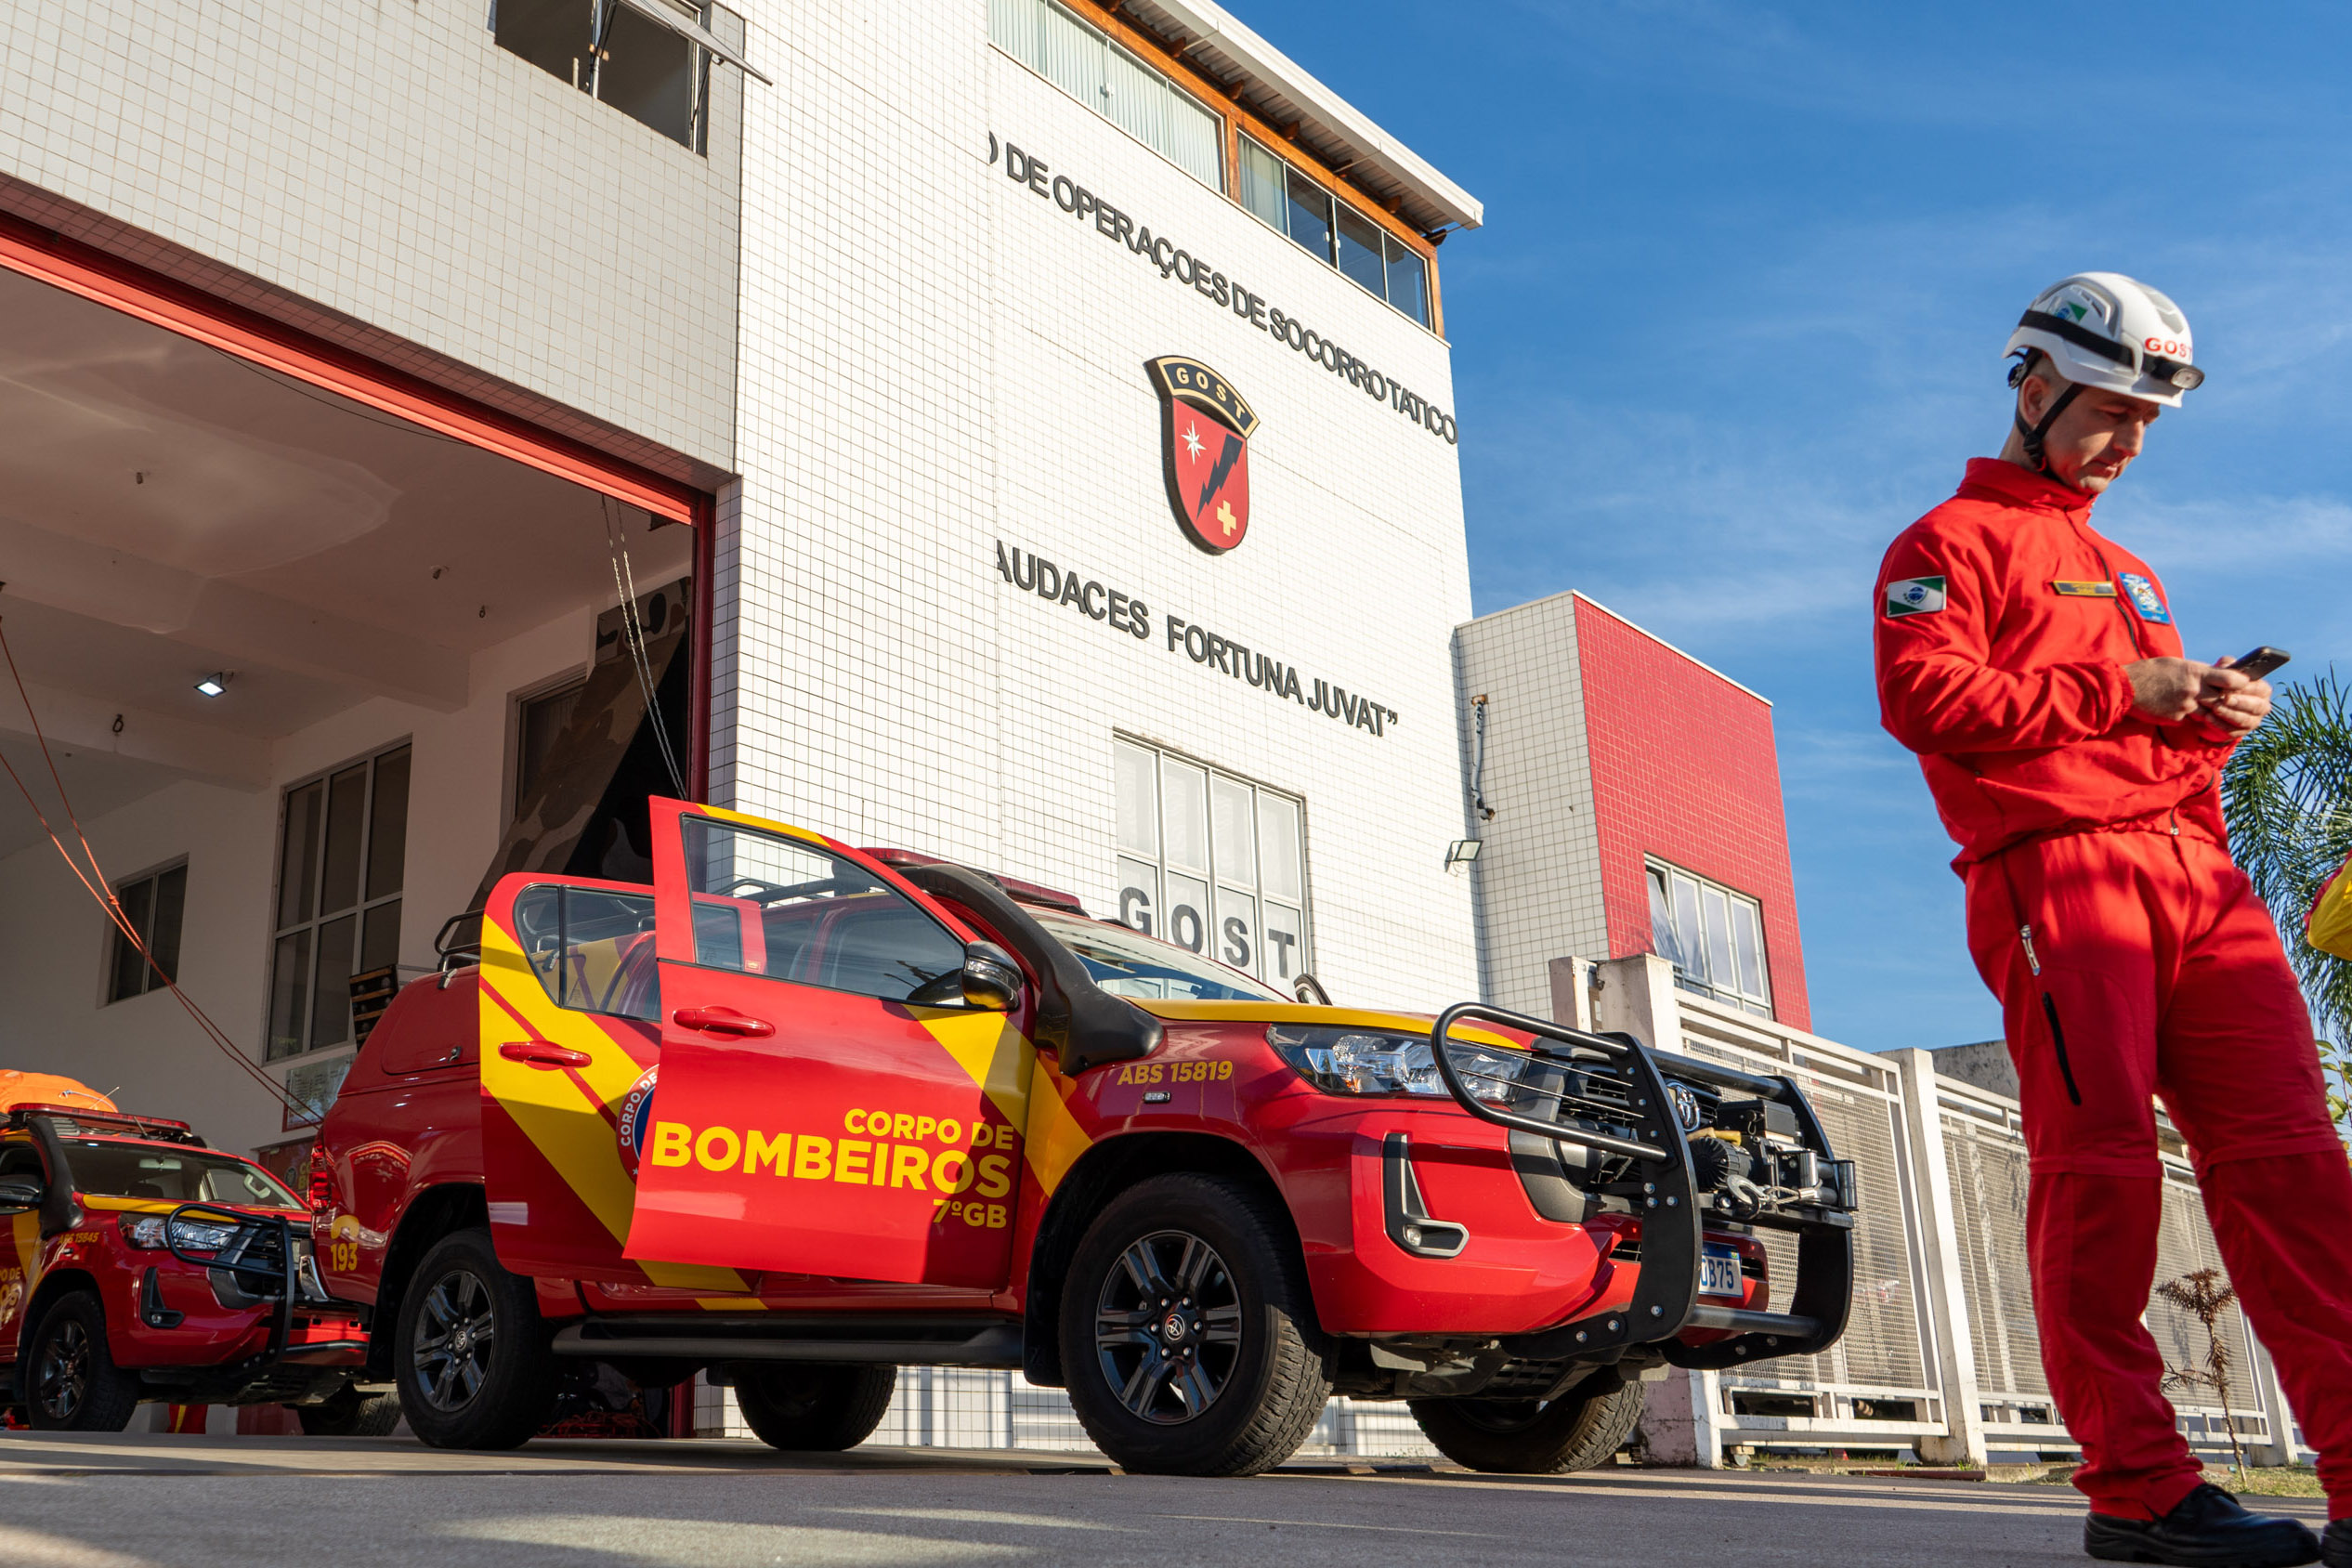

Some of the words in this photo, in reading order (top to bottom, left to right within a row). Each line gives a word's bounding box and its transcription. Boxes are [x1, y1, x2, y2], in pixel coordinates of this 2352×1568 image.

[1006, 142, 1050, 199] DE
[1233, 281, 1268, 331] DE
[1270, 307, 1387, 401] SOCORRO
[1386, 377, 1458, 445] TATICO
[1177, 367, 1246, 419] GOST
[1168, 614, 1304, 705] FORTUNA
[1119, 886, 1295, 978] GOST
[621, 1092, 640, 1146] CORPO
[639, 1072, 658, 1091] DE
[1117, 1064, 1164, 1085] ABS
[1170, 1061, 1233, 1082] 15819
[651, 1121, 1013, 1198] BOMBEIROS
[844, 1108, 961, 1144] CORPO
[971, 1122, 1014, 1151] DE
[331, 1243, 358, 1272] 193
